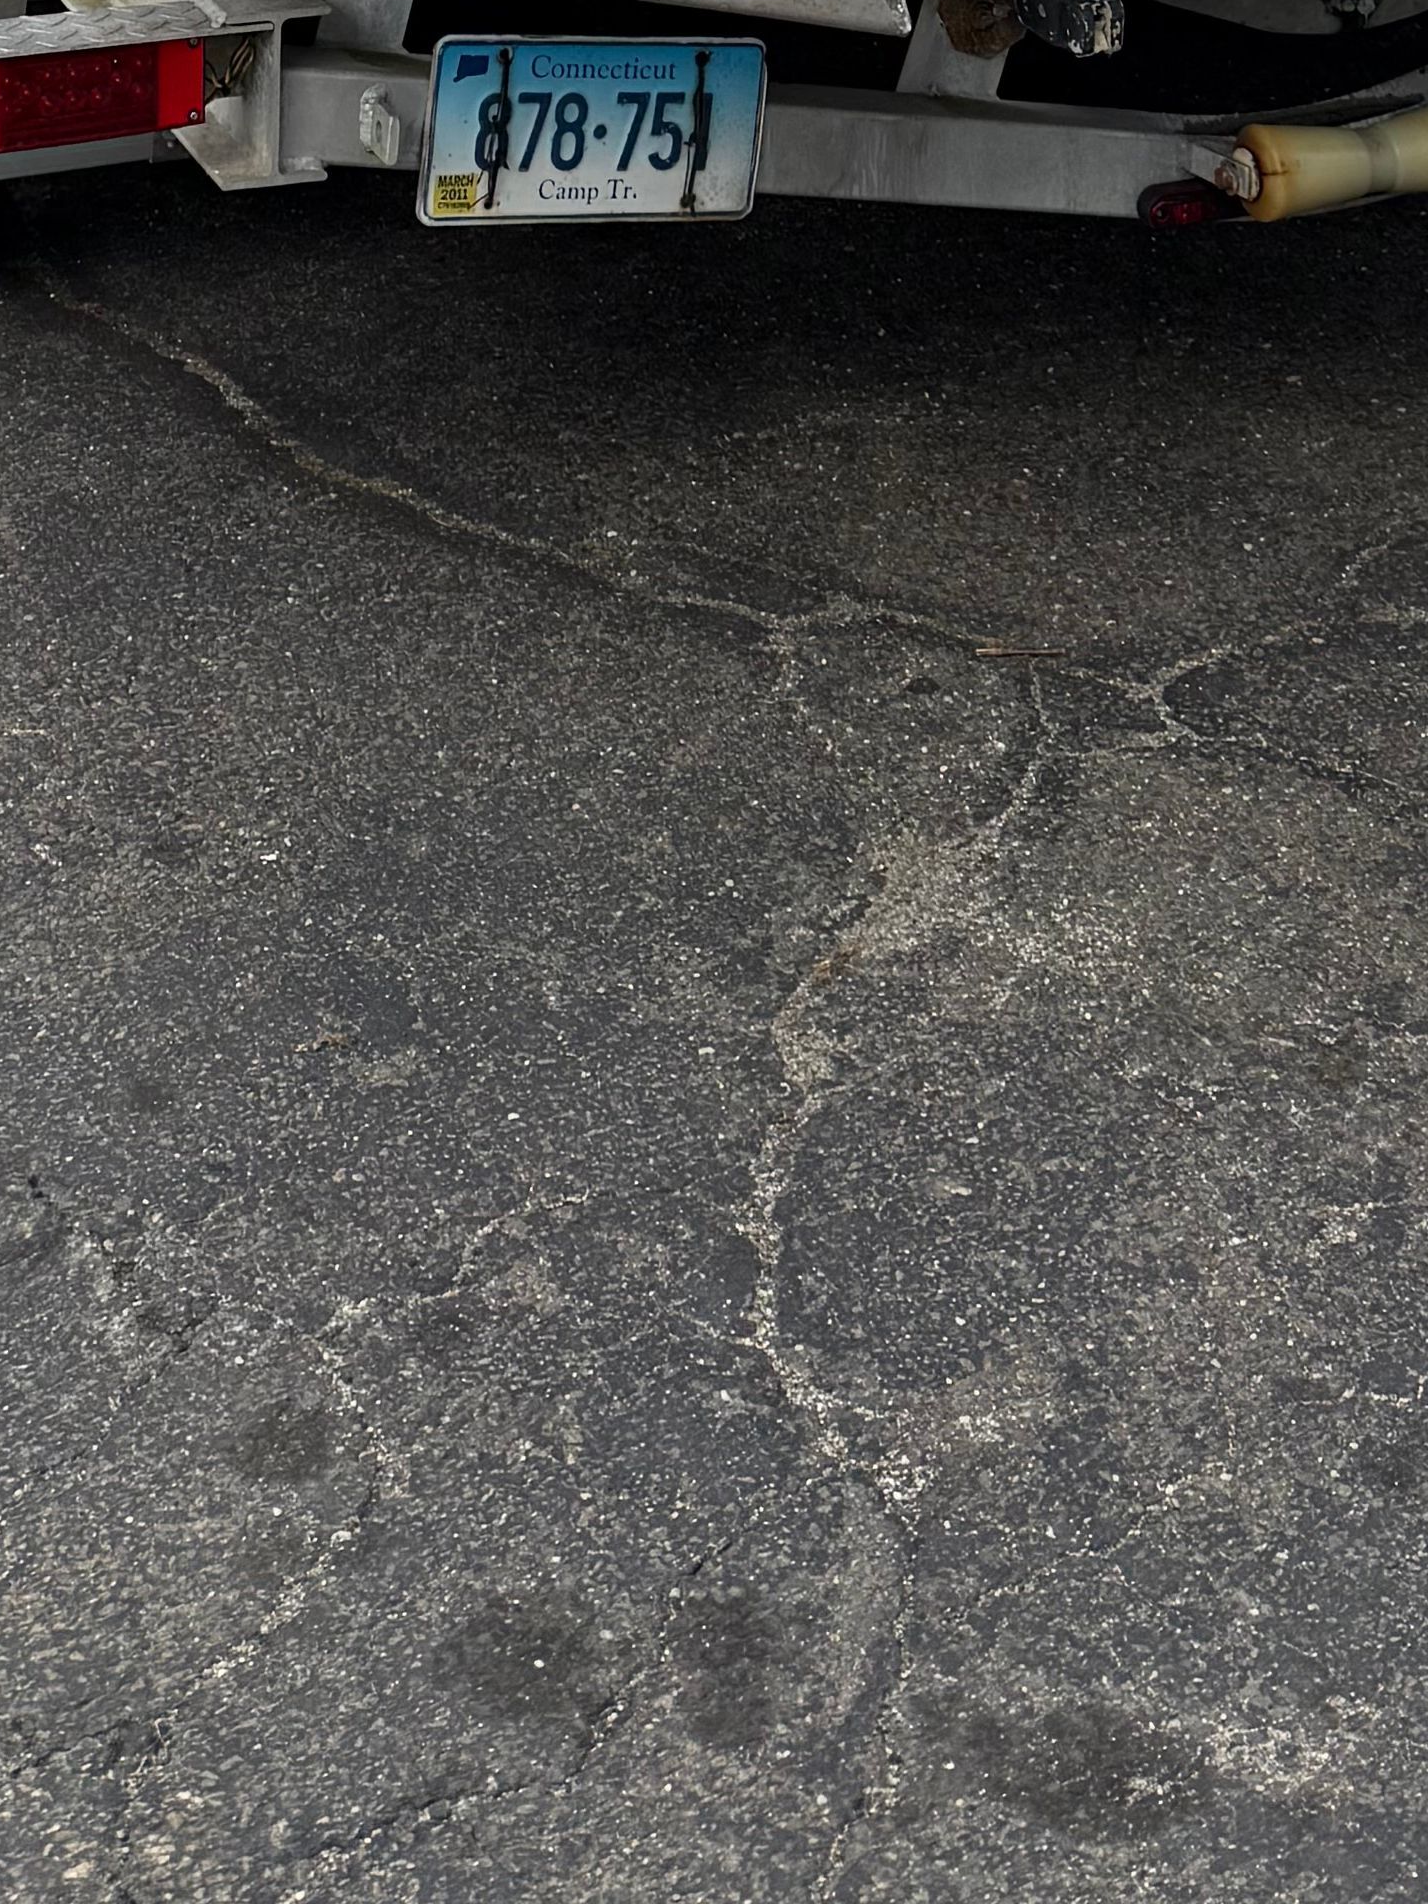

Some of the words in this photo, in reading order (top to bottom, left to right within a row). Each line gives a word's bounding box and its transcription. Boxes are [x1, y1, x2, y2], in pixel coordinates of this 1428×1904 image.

[531, 55, 676, 81] Connecticut
[437, 174, 474, 188] MARCH
[440, 188, 468, 200] 2011
[538, 179, 599, 204] Camp
[607, 179, 638, 201] Tr.
